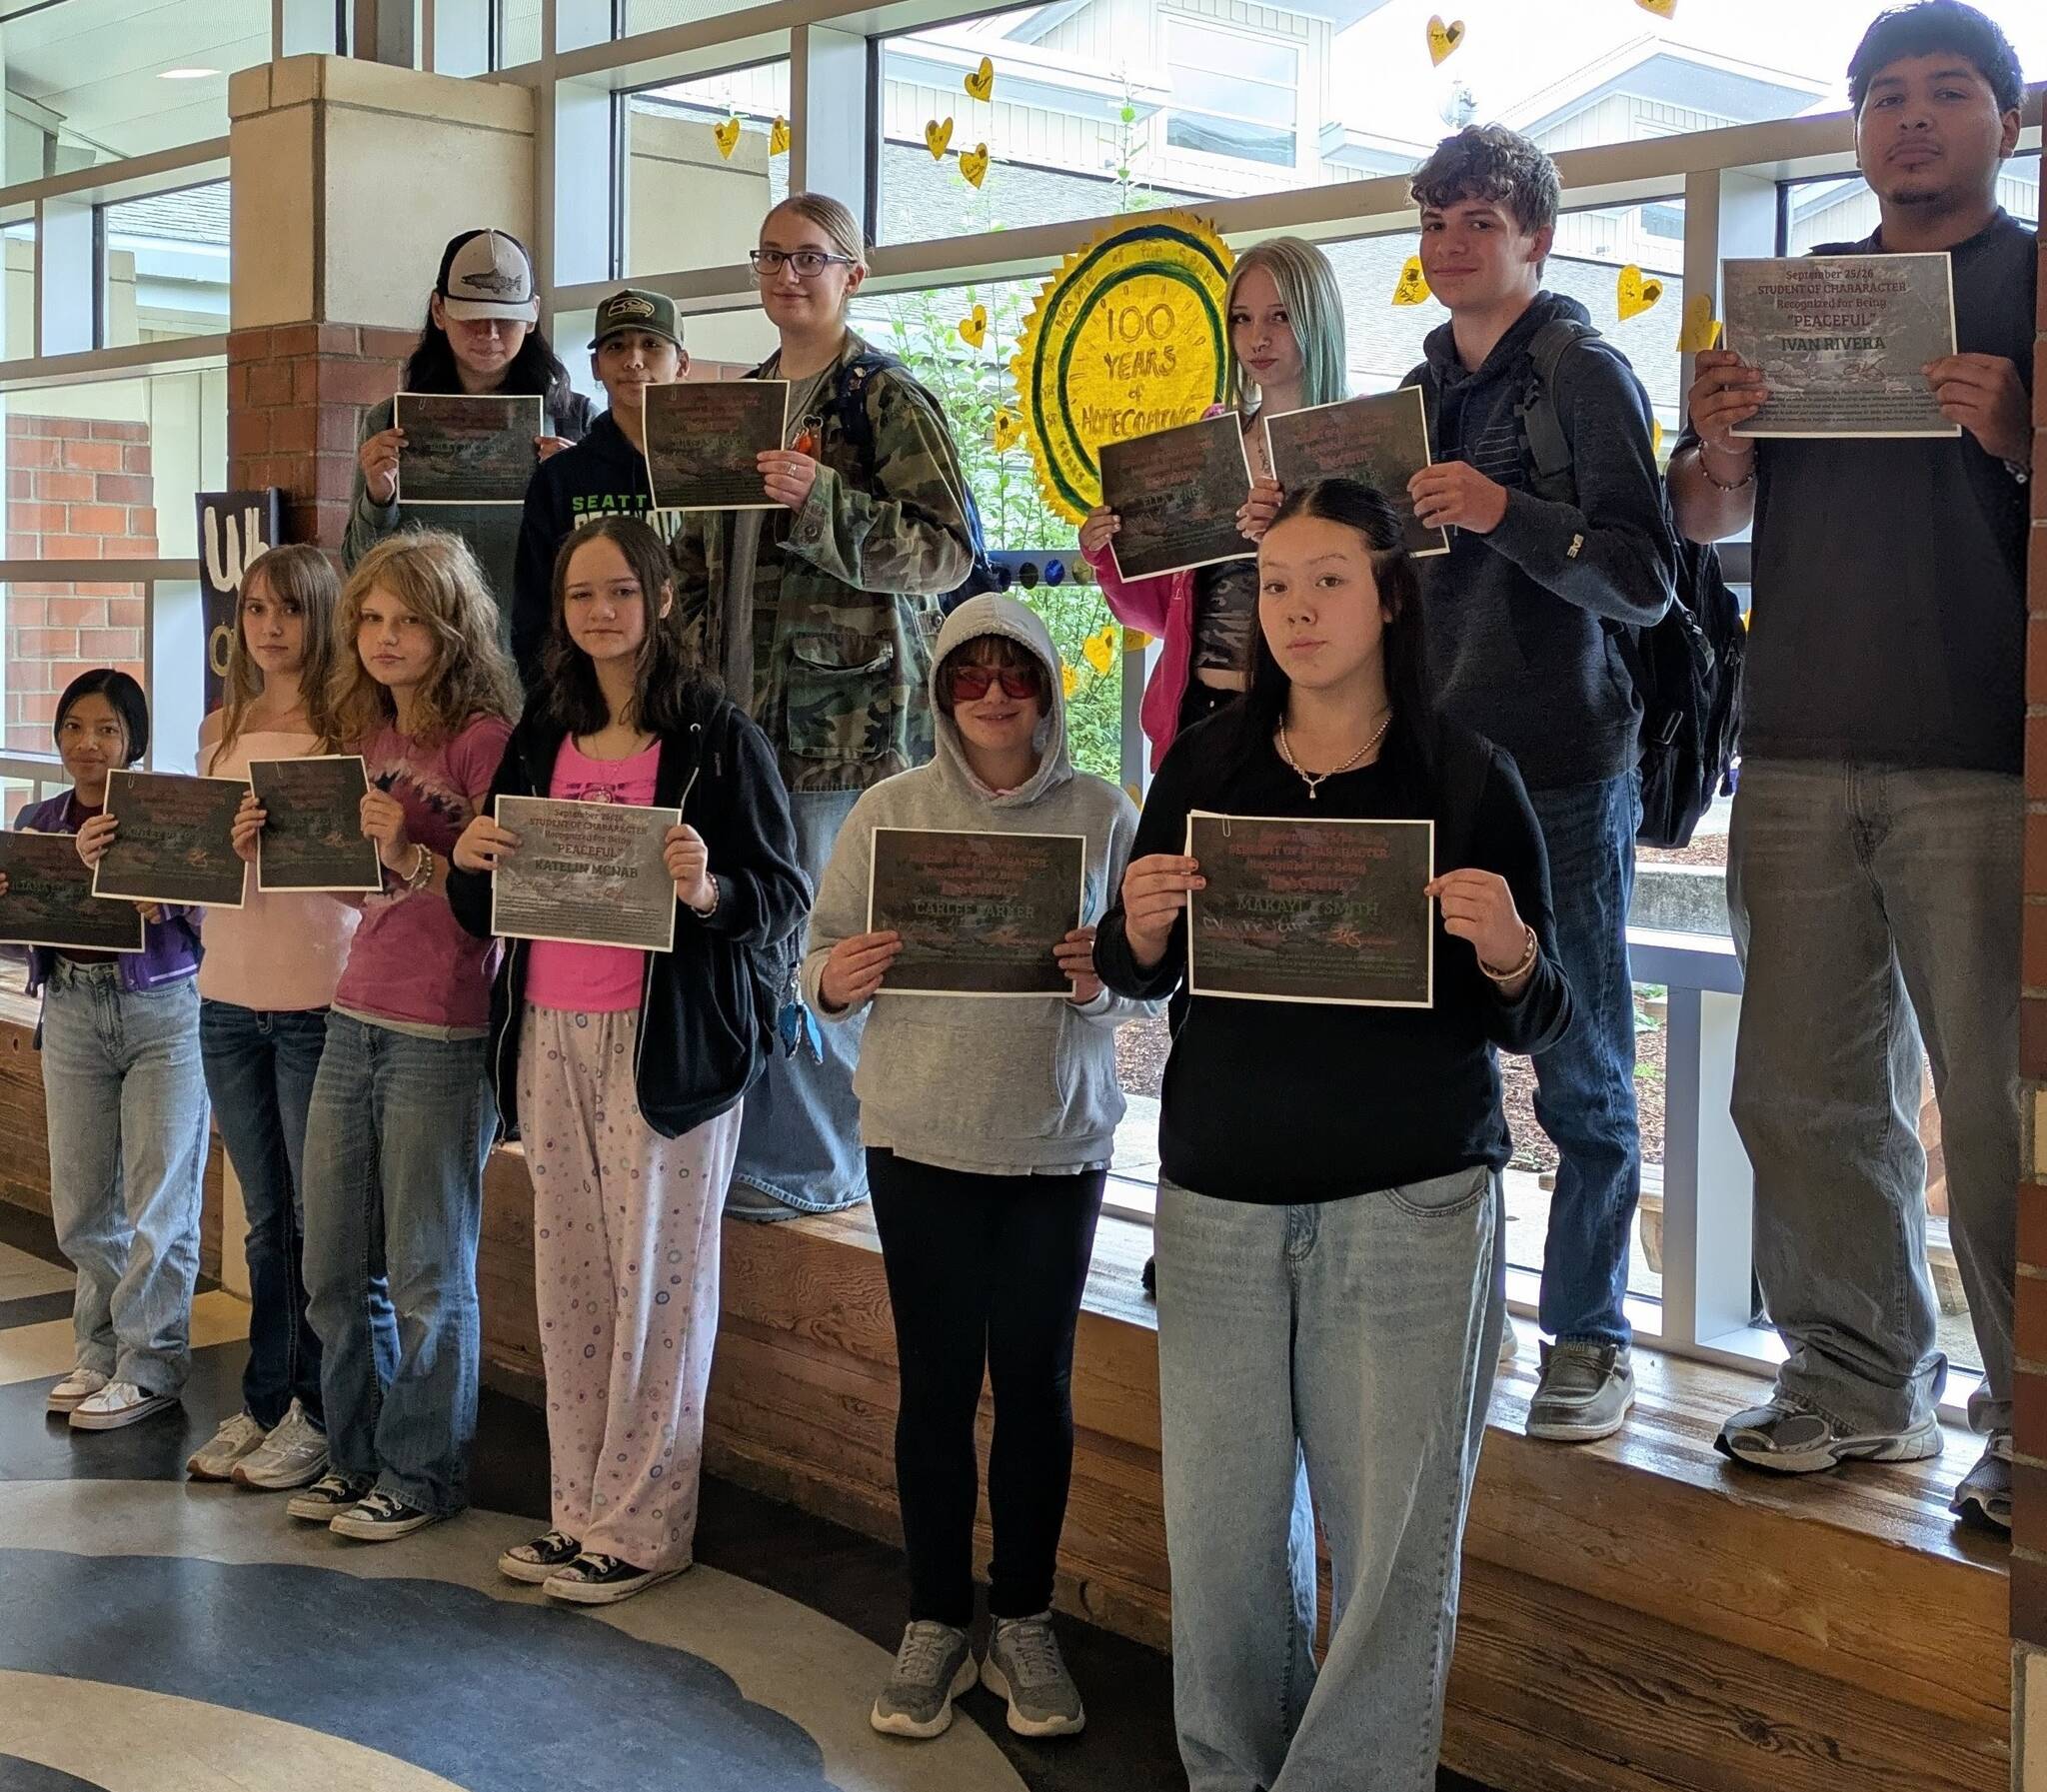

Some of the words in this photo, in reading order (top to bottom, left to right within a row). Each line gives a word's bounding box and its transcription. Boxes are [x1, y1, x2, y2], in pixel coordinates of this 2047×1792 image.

[1785, 269, 1842, 282] September
[1844, 268, 1874, 281] 25/26
[1758, 284, 1805, 295] STUDENT
[1807, 284, 1822, 295] OF
[1776, 299, 1835, 311] Recognized
[1836, 298, 1853, 308] for
[1856, 298, 1887, 310] Being
[1107, 303, 1175, 344] 100
[1787, 313, 1876, 328] "PEACEFUL"
[1781, 337, 1822, 351] IVAN
[1824, 336, 1886, 351] RIVERA
[1103, 345, 1176, 380] YEARS
[1127, 383, 1144, 402] of
[572, 494, 648, 512] SEATT
[535, 860, 590, 874] KATELIN
[591, 864, 639, 879] MCNAB
